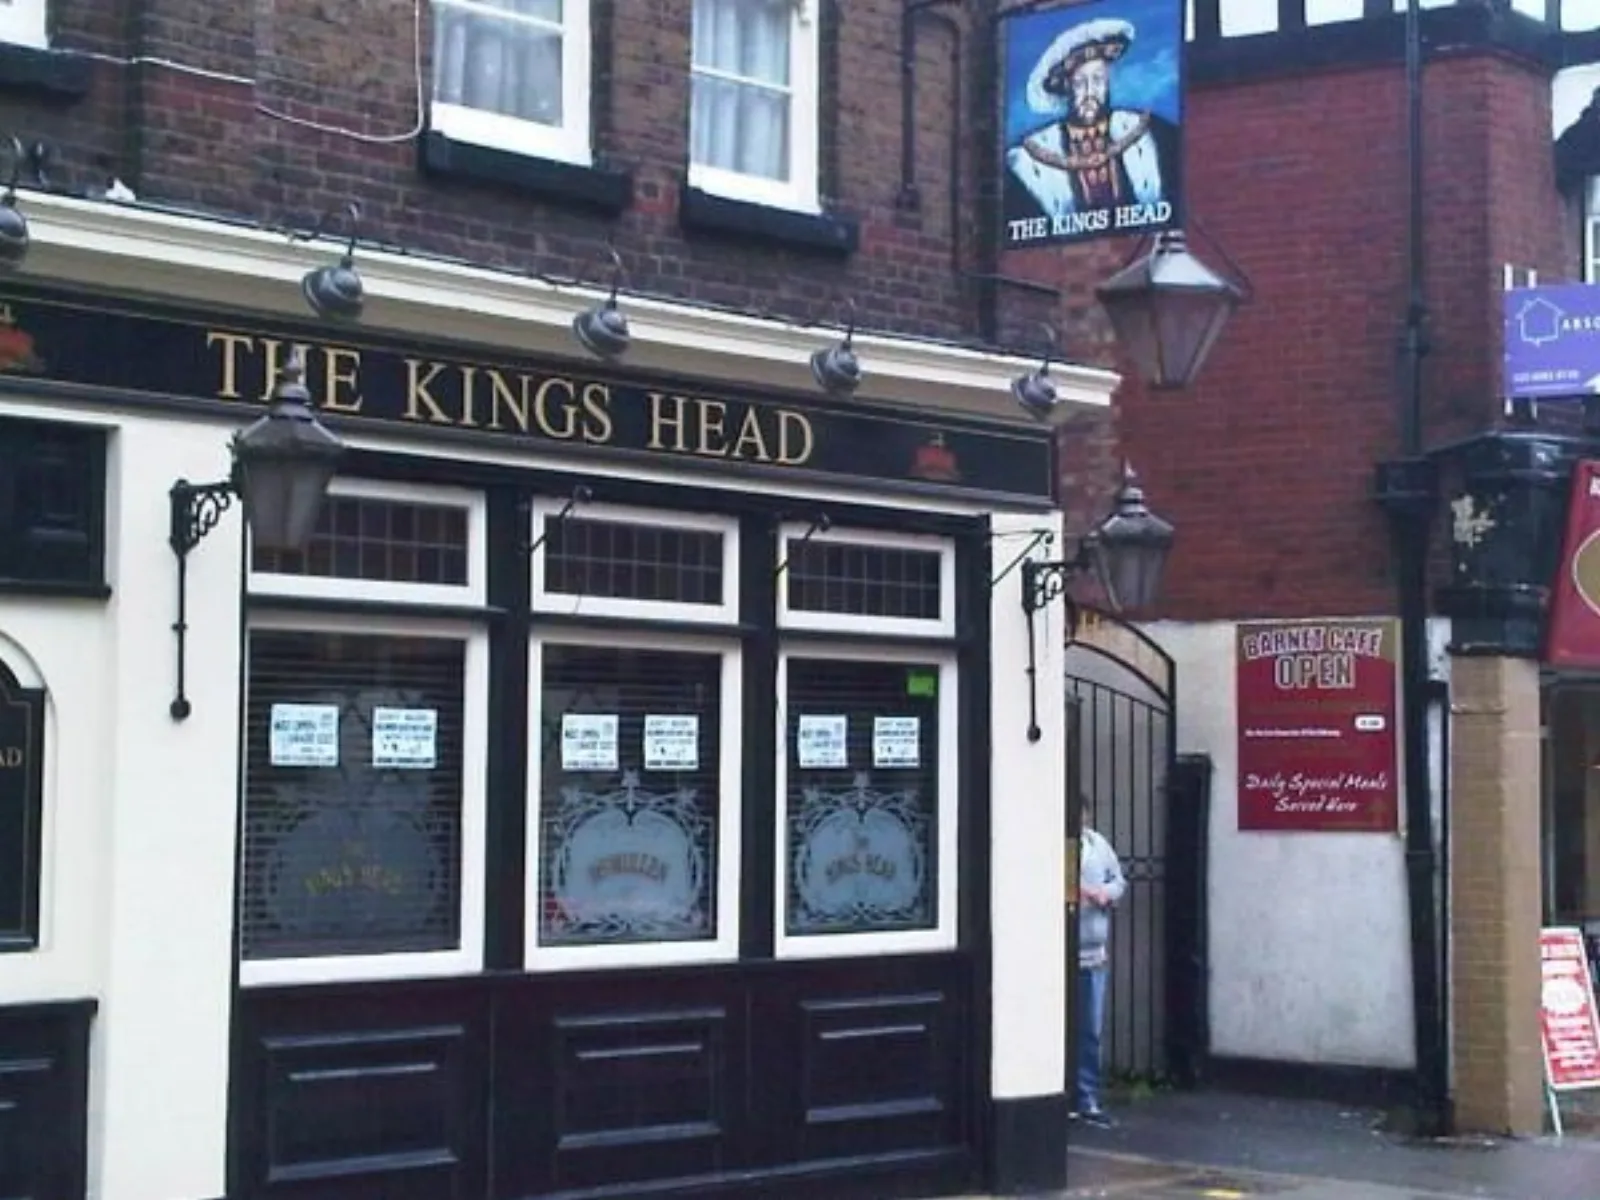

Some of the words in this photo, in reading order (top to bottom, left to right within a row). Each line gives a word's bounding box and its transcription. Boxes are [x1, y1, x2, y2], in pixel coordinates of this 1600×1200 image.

[1008, 217, 1047, 241] THE
[1052, 209, 1109, 236] KINGS
[1115, 201, 1172, 228] HEAD
[207, 331, 363, 412] THE
[404, 359, 612, 442] KINGS
[647, 391, 815, 465] HEAD
[1244, 626, 1325, 660] BARNET
[1328, 627, 1382, 657] CAFE
[1275, 652, 1356, 690] OPEN
